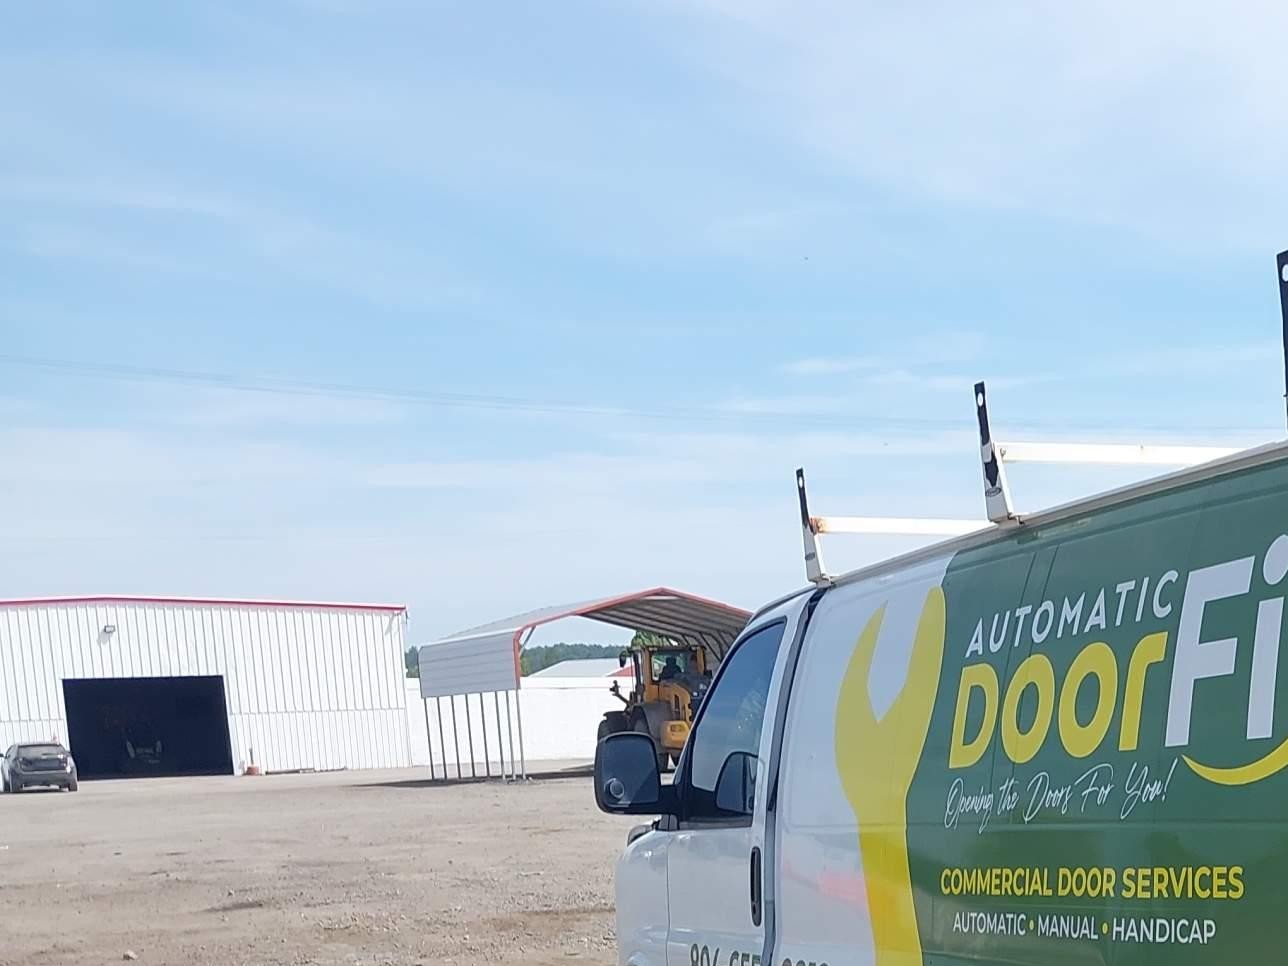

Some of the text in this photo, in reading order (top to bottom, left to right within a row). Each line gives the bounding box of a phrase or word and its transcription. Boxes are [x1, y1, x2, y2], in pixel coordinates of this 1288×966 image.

[965, 570, 1179, 657] AUTOMATIC
[944, 757, 1178, 834] Opening the Doors For You!
[941, 865, 1245, 899] COMMERCIAL DOOR SERVICES
[953, 912, 1216, 945] AUTOMATIC MANUAL HANDICAP
